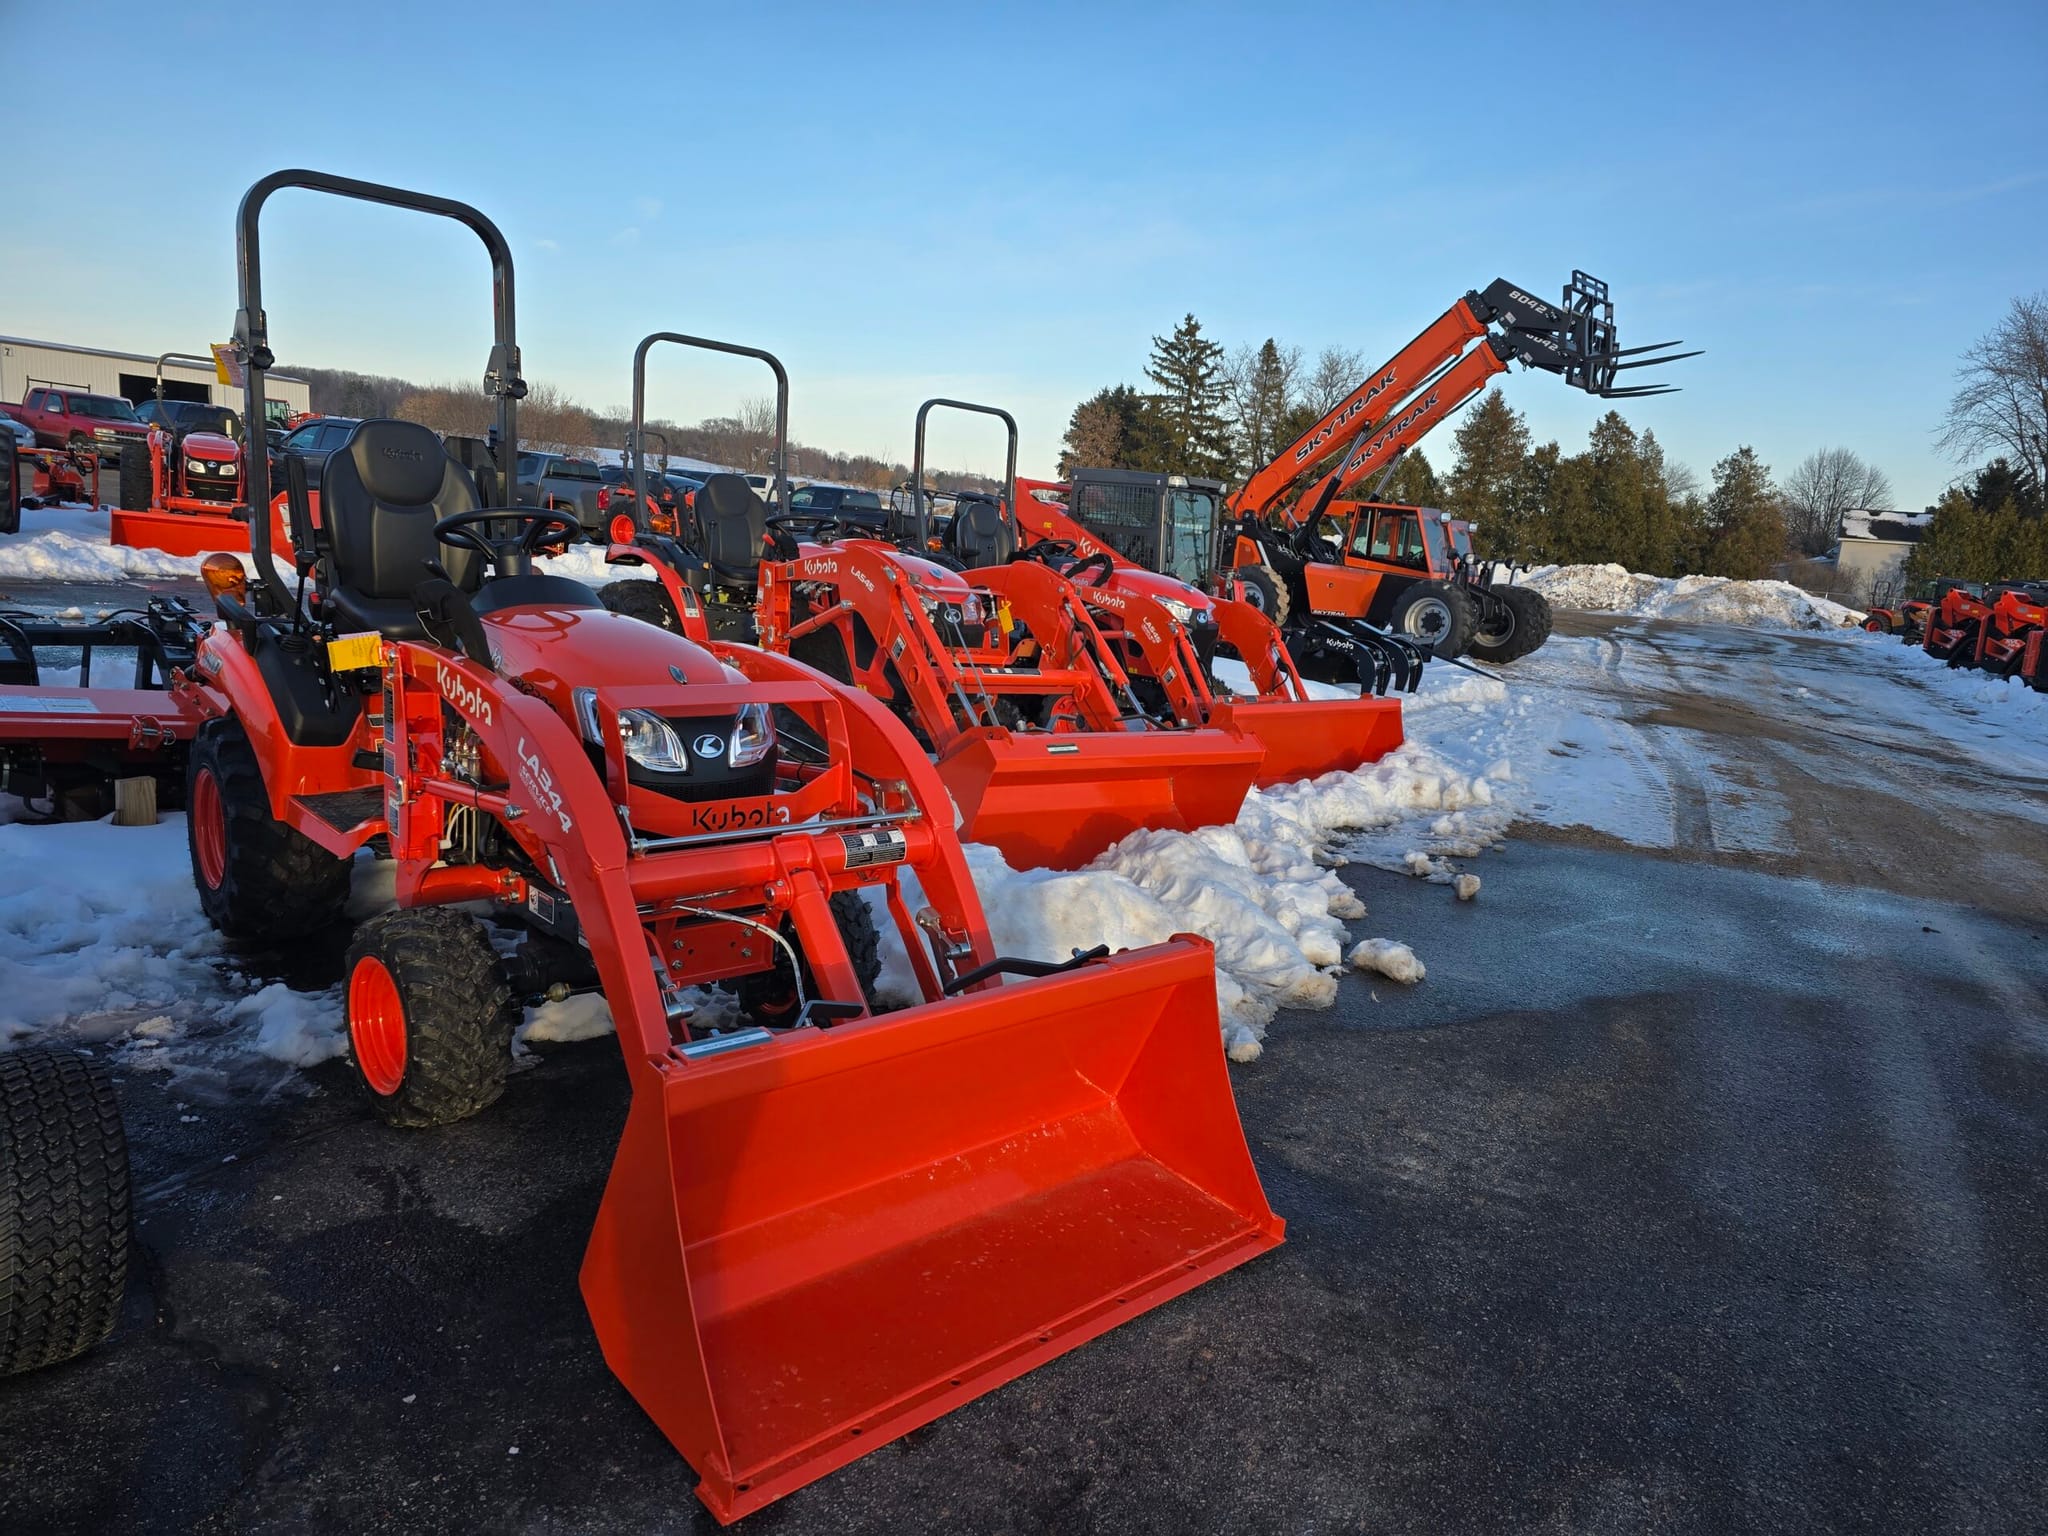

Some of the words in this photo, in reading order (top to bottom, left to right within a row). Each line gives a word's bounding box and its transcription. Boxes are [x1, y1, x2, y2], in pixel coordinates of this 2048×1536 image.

[1508, 290, 1548, 314] 8042
[1296, 366, 1398, 464] SKYTRAK
[1350, 389, 1440, 474] SKYTRAK
[804, 558, 838, 575] Kubota
[850, 565, 875, 592] LA545
[1093, 591, 1126, 609] Kubota
[1326, 638, 1354, 650] Kubota
[436, 661, 493, 727] Kubota
[517, 736, 573, 834] LA344
[519, 765, 554, 817] SERVICE
[692, 801, 790, 831] Kubota
